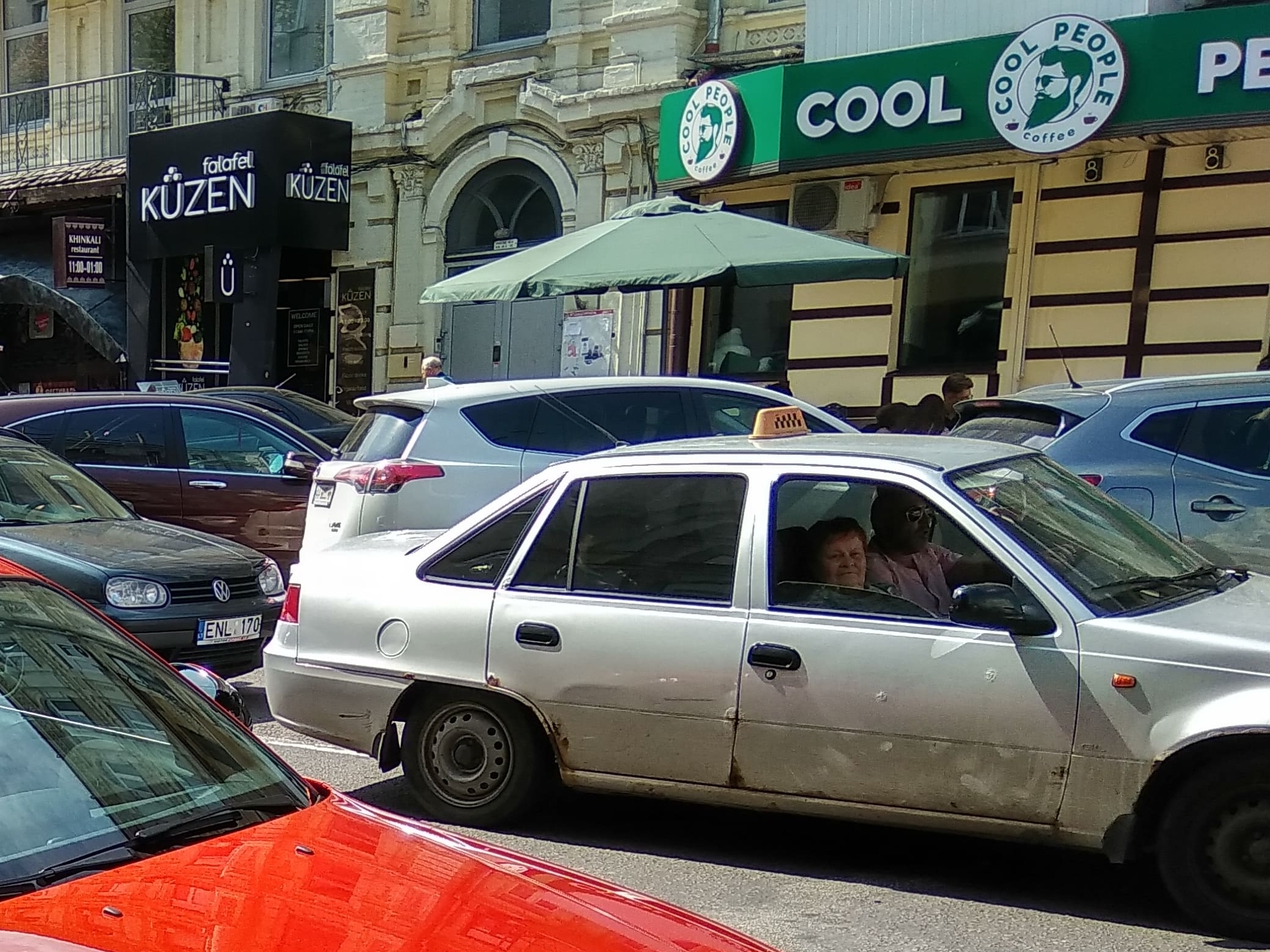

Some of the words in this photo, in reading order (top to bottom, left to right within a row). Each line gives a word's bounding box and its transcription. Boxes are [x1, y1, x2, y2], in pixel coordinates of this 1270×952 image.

[995, 40, 1039, 115] COOL
[1054, 22, 1118, 107] PEOPLE
[796, 75, 962, 138] COOL
[1198, 37, 1270, 93] PE
[682, 100, 700, 154] COOL
[706, 86, 733, 146] PEOPLE
[1023, 128, 1076, 143] coffee
[202, 150, 255, 175] falafel
[320, 162, 349, 178] falafel
[694, 162, 717, 174] coffee
[141, 166, 255, 222] KÜZEN
[286, 162, 349, 203] KÜZEN
[68, 234, 101, 244] KHINKALI
[70, 246, 99, 254] restaurant
[205, 621, 232, 638] ENL
[241, 617, 260, 635] 170
